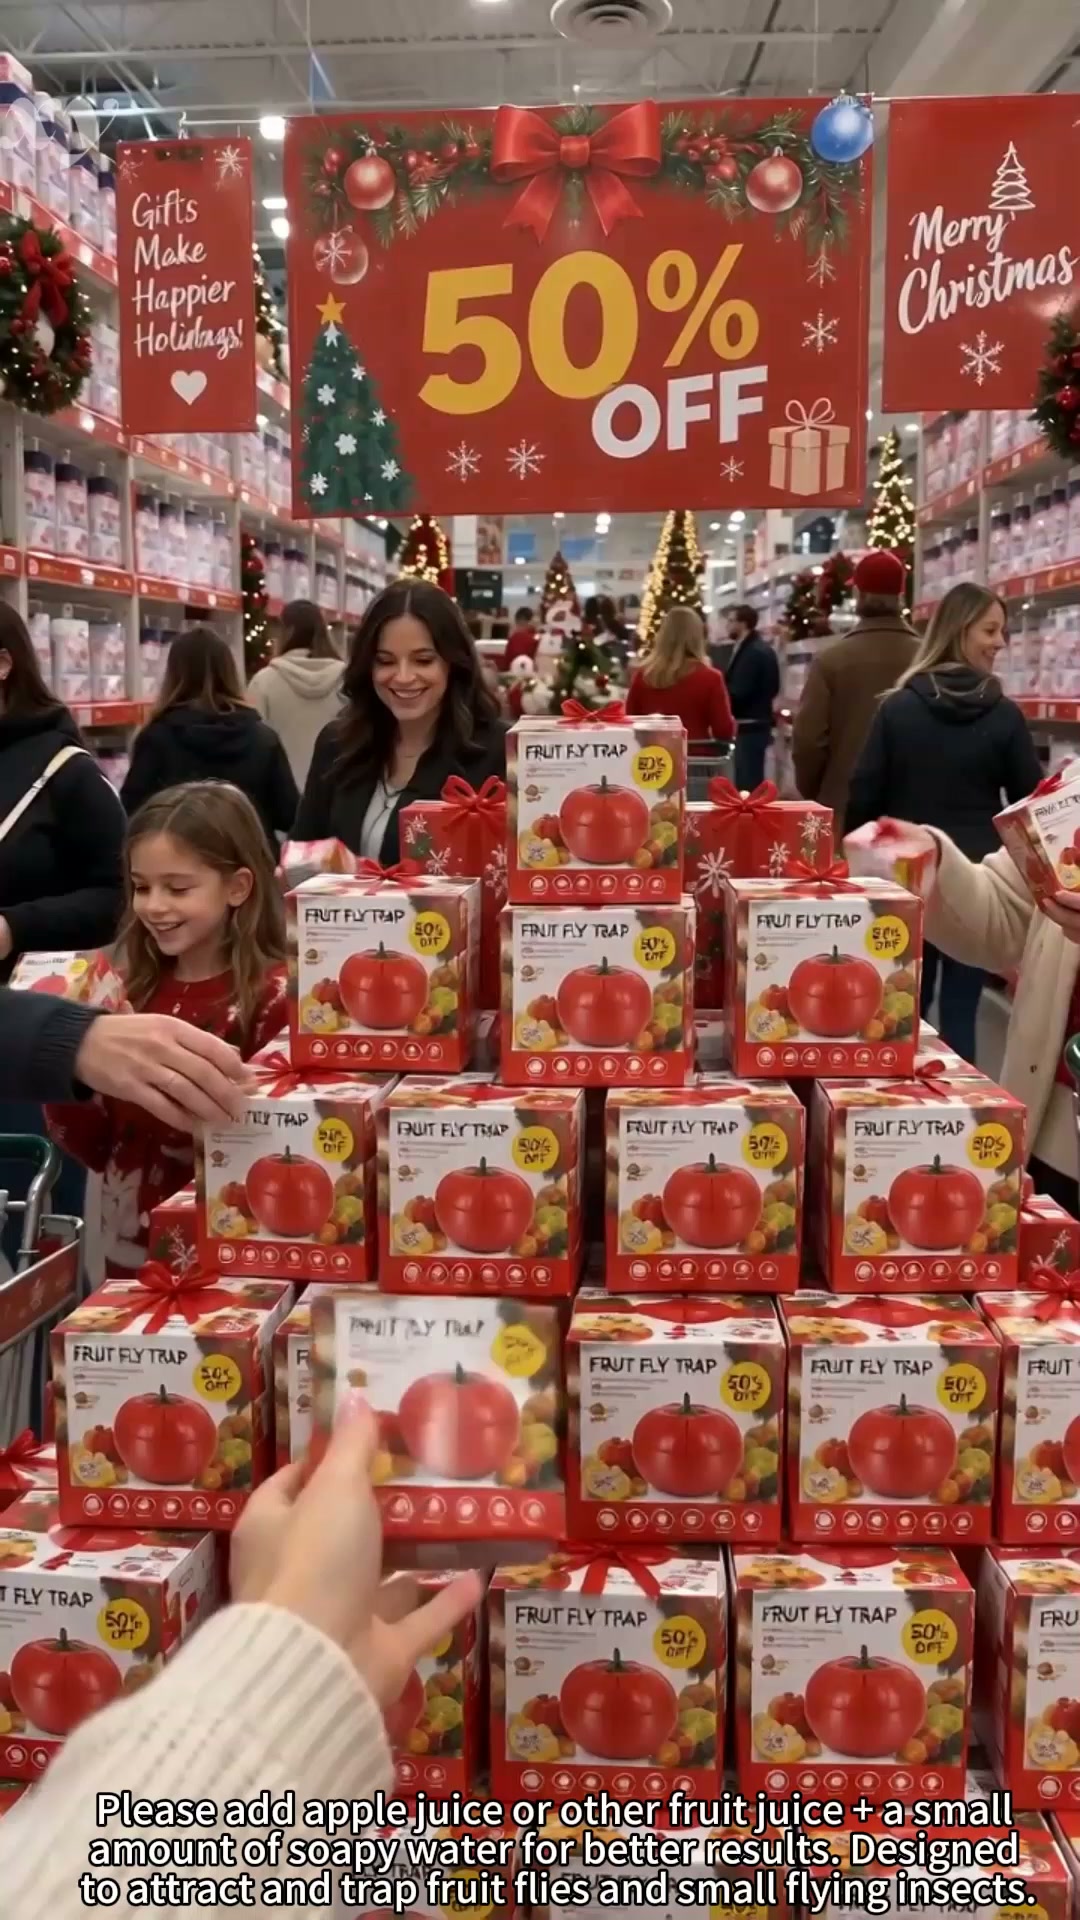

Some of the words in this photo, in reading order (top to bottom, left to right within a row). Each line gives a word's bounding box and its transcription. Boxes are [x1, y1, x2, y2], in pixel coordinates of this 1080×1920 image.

[132, 188, 199, 230] Gifts
[135, 233, 208, 274] Make
[911, 205, 1008, 261] Merry
[132, 274, 236, 318] Happier
[898, 246, 1080, 335] Christmas
[418, 244, 760, 416] 50%
[591, 364, 769, 459] OFF
[639, 1356, 669, 1374] FLY
[674, 1357, 717, 1375] TRAP
[14, 1587, 44, 1606] FLY
[47, 1589, 94, 1608] TRAP
[567, 1607, 599, 1626] FLY
[602, 1609, 648, 1628] TRAP
[814, 1605, 844, 1624] FLY
[849, 1606, 897, 1624] TRAP
